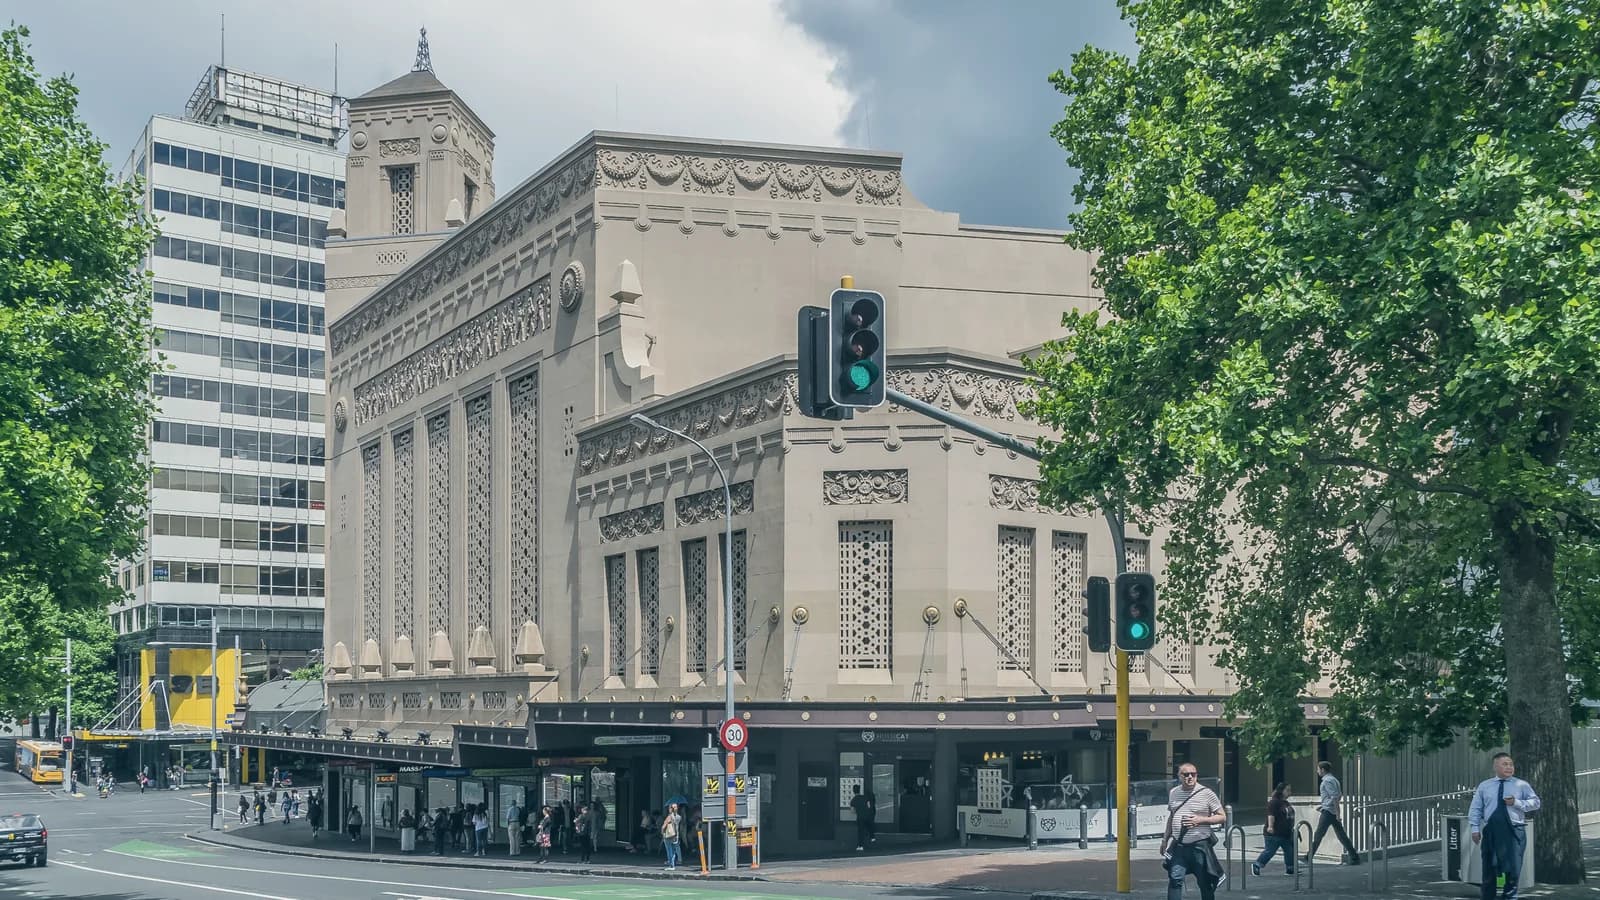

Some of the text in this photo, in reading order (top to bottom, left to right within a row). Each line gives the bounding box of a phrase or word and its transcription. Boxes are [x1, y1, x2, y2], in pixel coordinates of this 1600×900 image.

[149, 675, 220, 695] SB
[727, 729, 742, 742] 30
[1449, 826, 1458, 850] Litter
